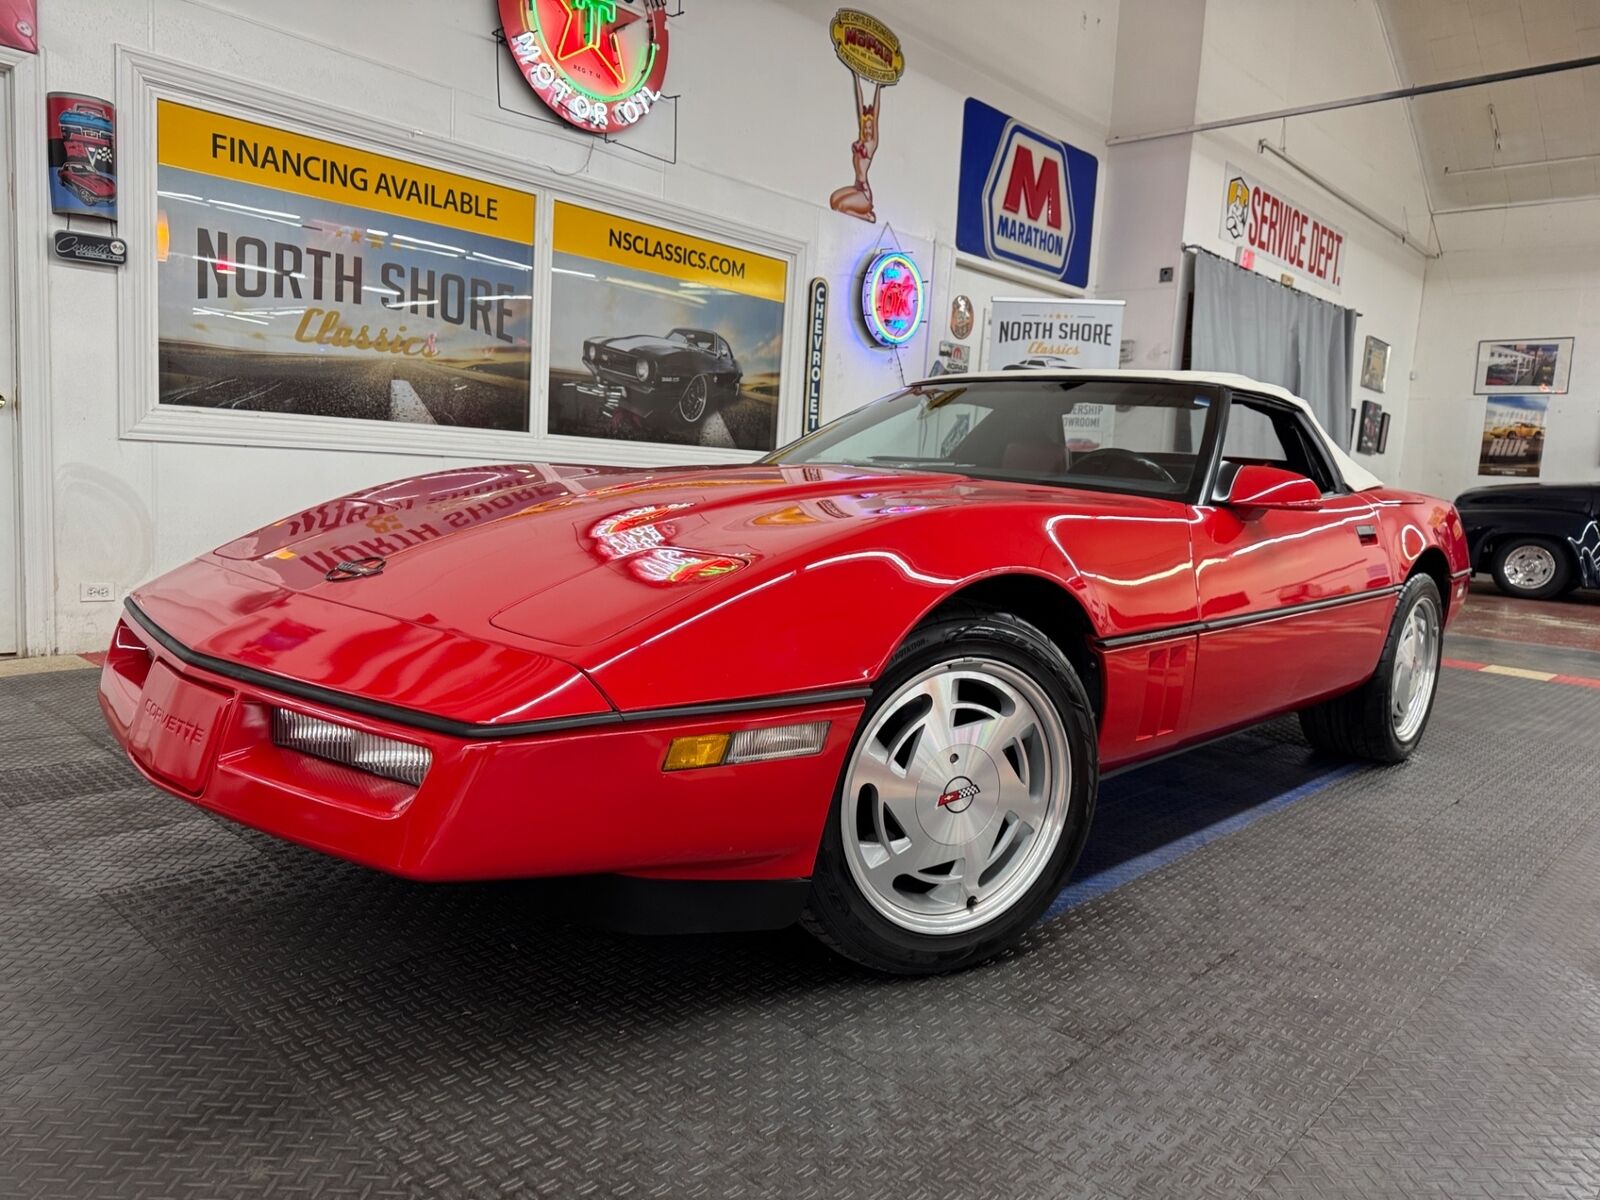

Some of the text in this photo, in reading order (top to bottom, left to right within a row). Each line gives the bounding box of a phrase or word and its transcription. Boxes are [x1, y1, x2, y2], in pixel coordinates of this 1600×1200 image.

[844, 26, 893, 68] MOPAR
[512, 31, 609, 129] MOTOR
[617, 86, 661, 124] OIL
[211, 133, 498, 221] FINANCING AVAILABLE
[609, 228, 746, 279] NSCLASSICS.COM
[997, 215, 1063, 256] MARATHON
[1248, 186, 1343, 286] SERVICE DEPT.
[197, 227, 515, 343] NORTH SHORE
[295, 307, 441, 358] Classics
[808, 286, 826, 430] CHEVROLET
[999, 321, 1113, 346] NORTH SHORE
[1027, 341, 1080, 356] Classics
[1488, 438, 1530, 457] RIDE
[145, 698, 205, 746] CORVETTE
